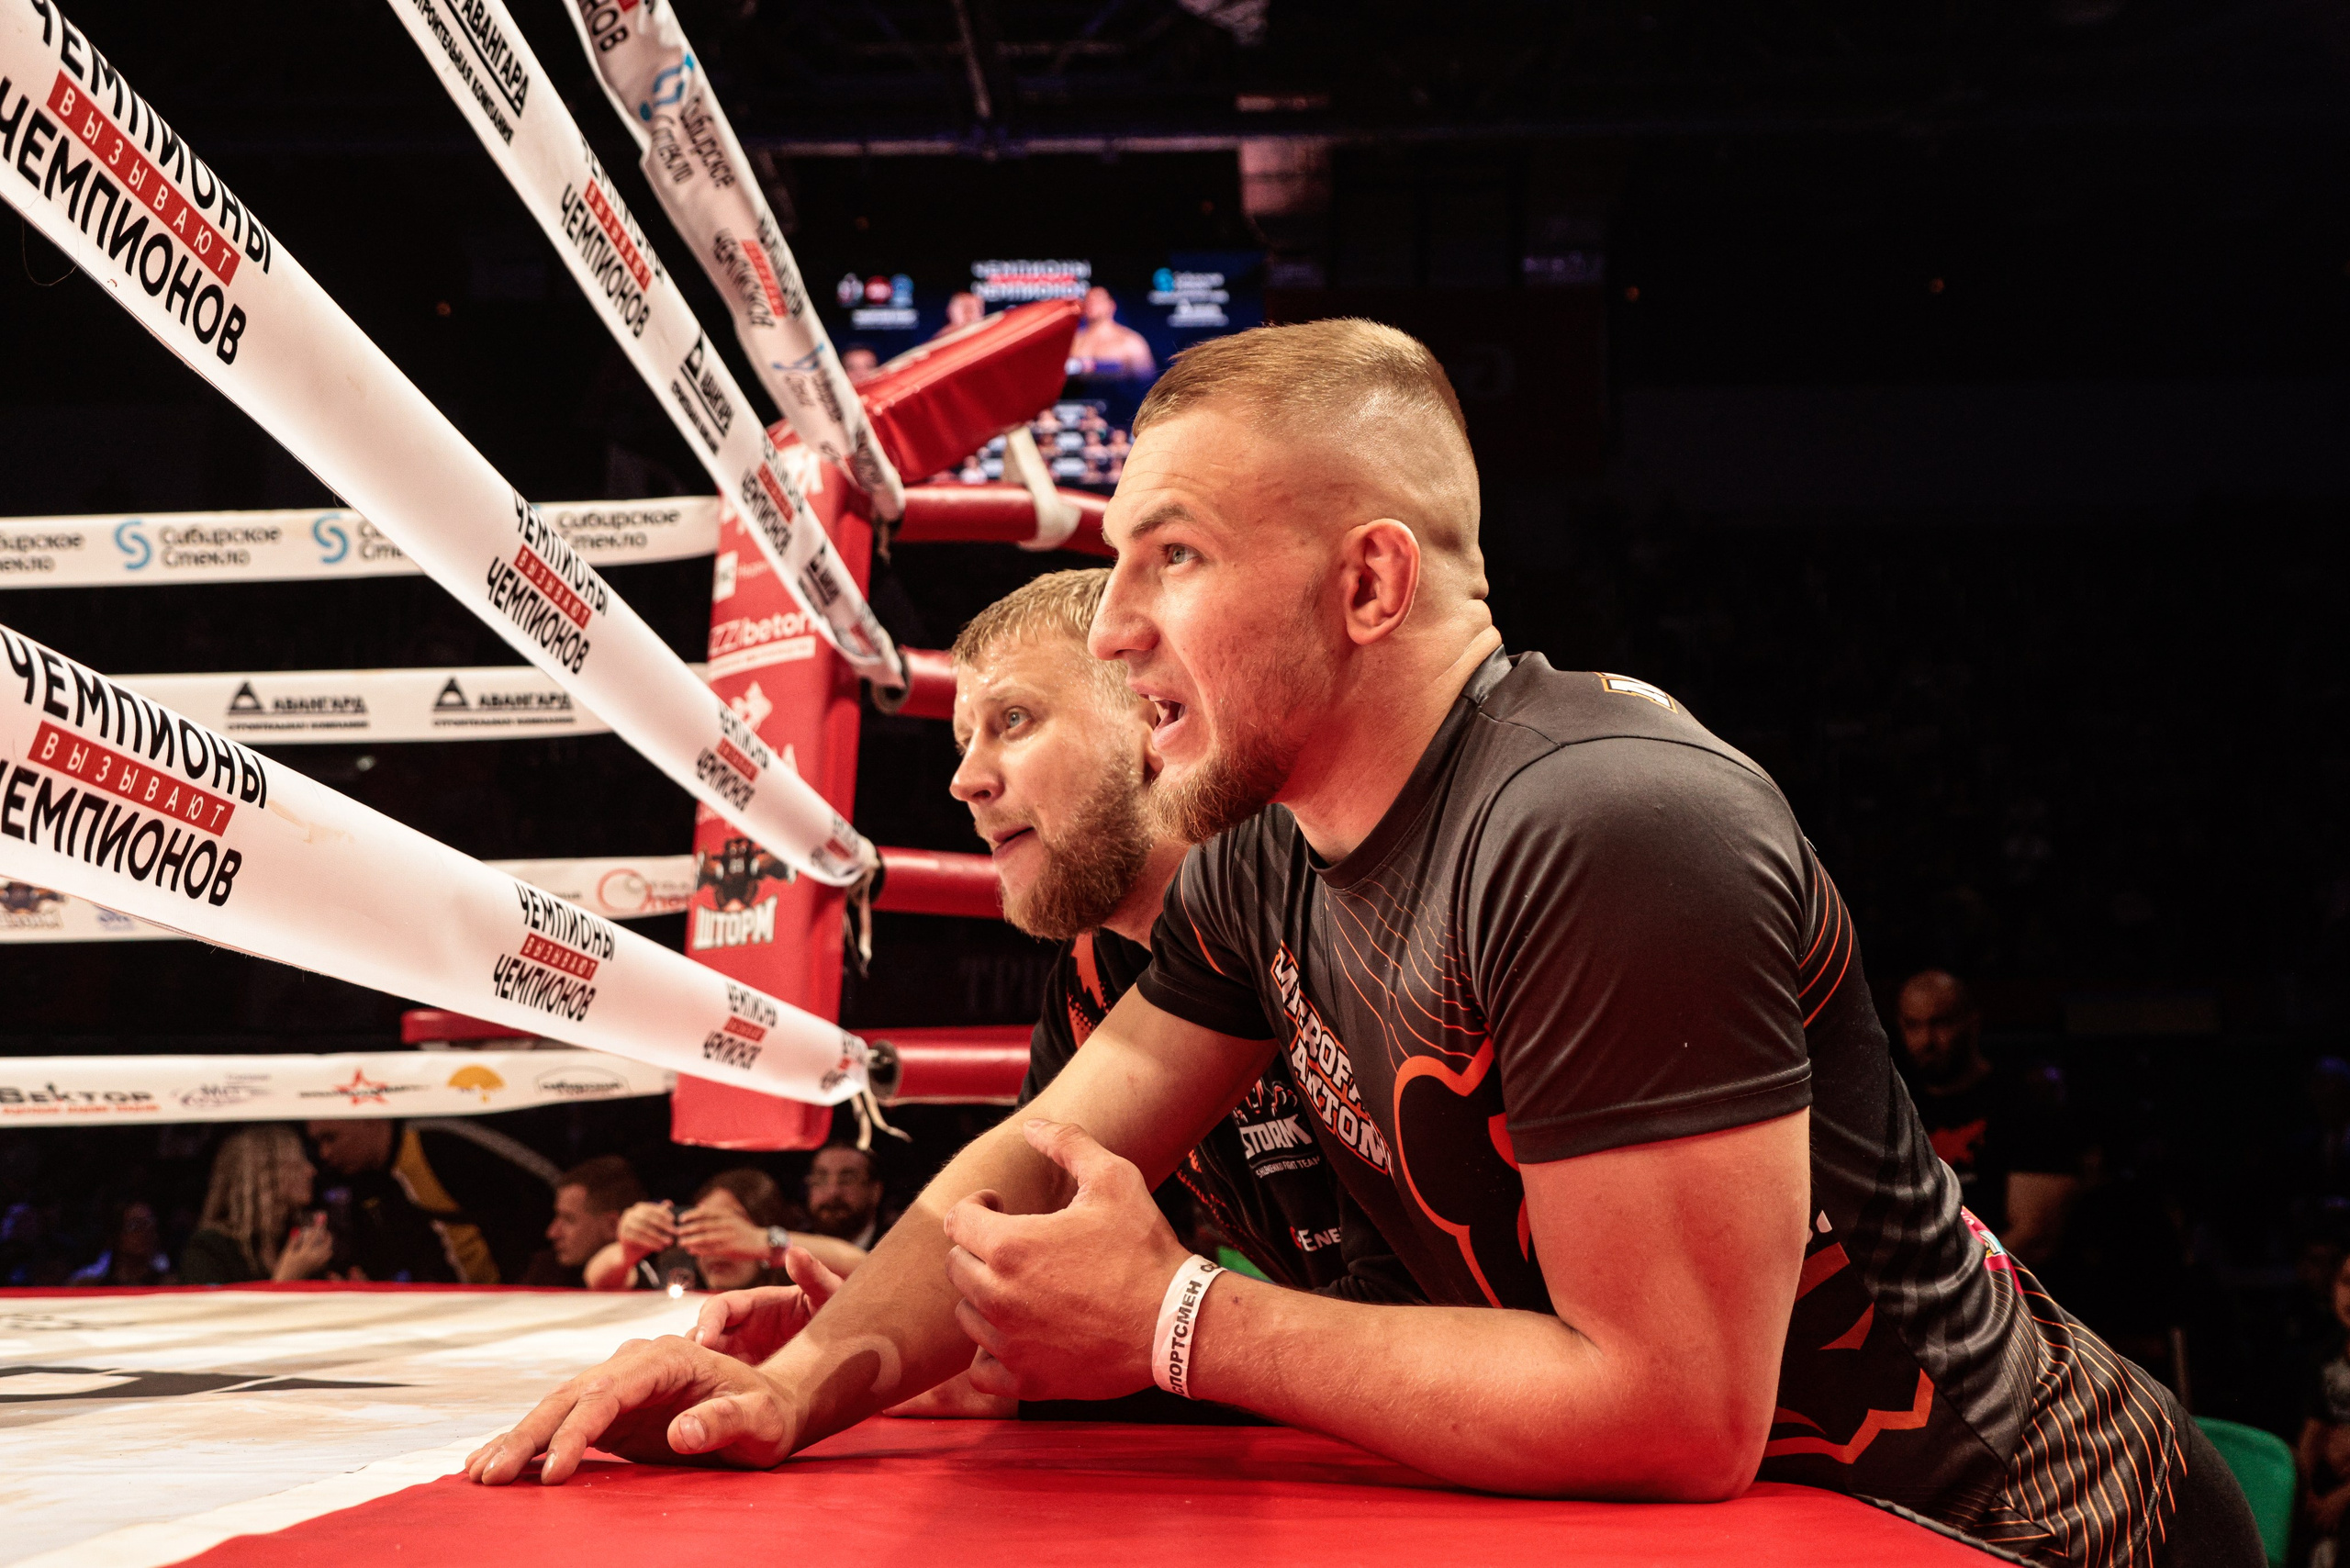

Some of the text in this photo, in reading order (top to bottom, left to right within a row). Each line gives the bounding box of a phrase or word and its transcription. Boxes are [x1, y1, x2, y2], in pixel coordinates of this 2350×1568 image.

[30, 0, 272, 274] ЧЕМПИОНЫ
[59, 86, 232, 273] ВЫЗЫВАЮТ
[0, 76, 247, 365] ЧЕМПИОНОВ
[561, 182, 651, 340] ЧЕМПИОНОВ
[511, 488, 609, 616] ЧЕМПИОНЫ
[517, 550, 590, 625] ВЫЗЫВАЮТ
[487, 556, 590, 675] ЧЕМПИОНОВ
[0, 629, 266, 809] ЧЕМПИОНЫ
[0, 759, 242, 907] ЕМПИОНОВ
[41, 732, 226, 828] ВЫЗЫВАЮТ
[514, 881, 615, 961] ЧЕМПИОНЫ
[692, 894, 778, 950] ШТОРМ
[493, 953, 597, 1022] ЧЕМПИОНОВ
[1239, 1114, 1314, 1160] STORM
[1169, 1280, 1203, 1395] СПОРТСМЕН
